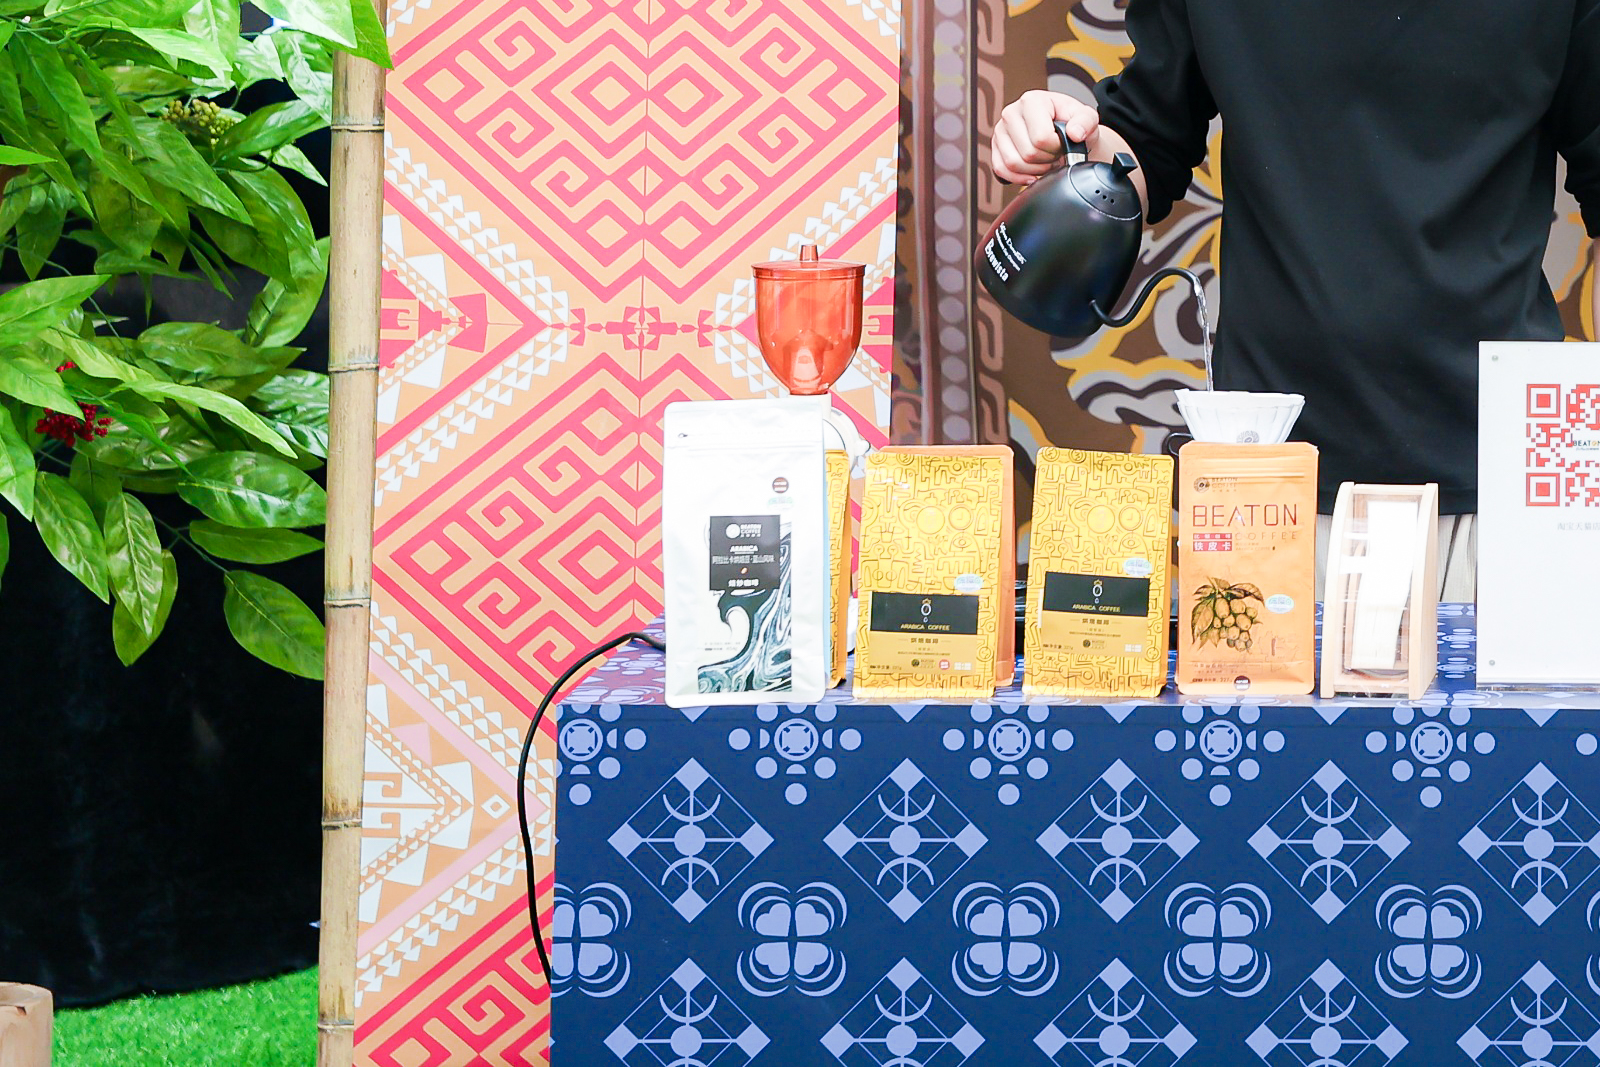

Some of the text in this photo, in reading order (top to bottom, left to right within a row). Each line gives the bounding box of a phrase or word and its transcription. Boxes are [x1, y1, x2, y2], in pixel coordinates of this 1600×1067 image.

[985, 238, 1009, 282] Brewista
[1192, 504, 1297, 527] BEATON
[1235, 531, 1298, 540] COFFEE
[1194, 542, 1231, 551] 铁皮卡
